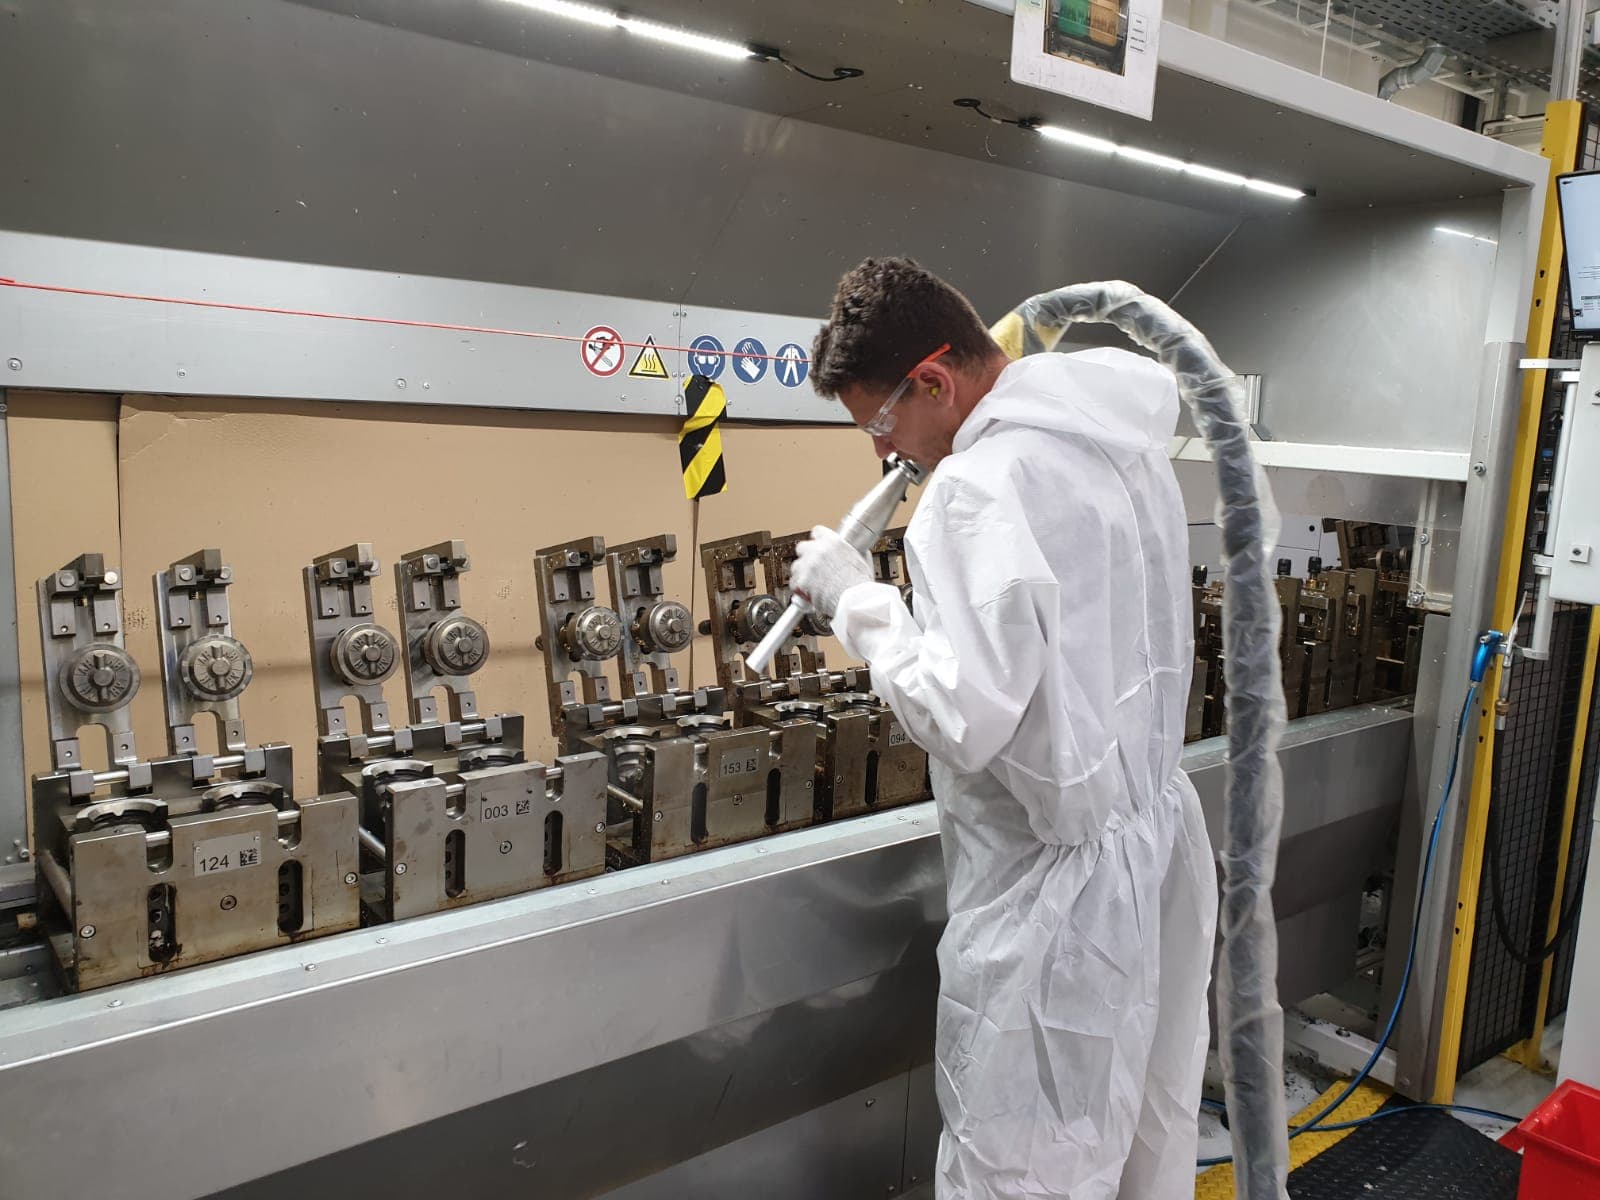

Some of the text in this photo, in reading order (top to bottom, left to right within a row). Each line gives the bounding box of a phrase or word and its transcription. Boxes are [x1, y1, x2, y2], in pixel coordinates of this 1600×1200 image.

[890, 732, 906, 745] 094
[723, 761, 741, 775] 153
[484, 804, 509, 820] 003
[199, 854, 230, 872] 124
